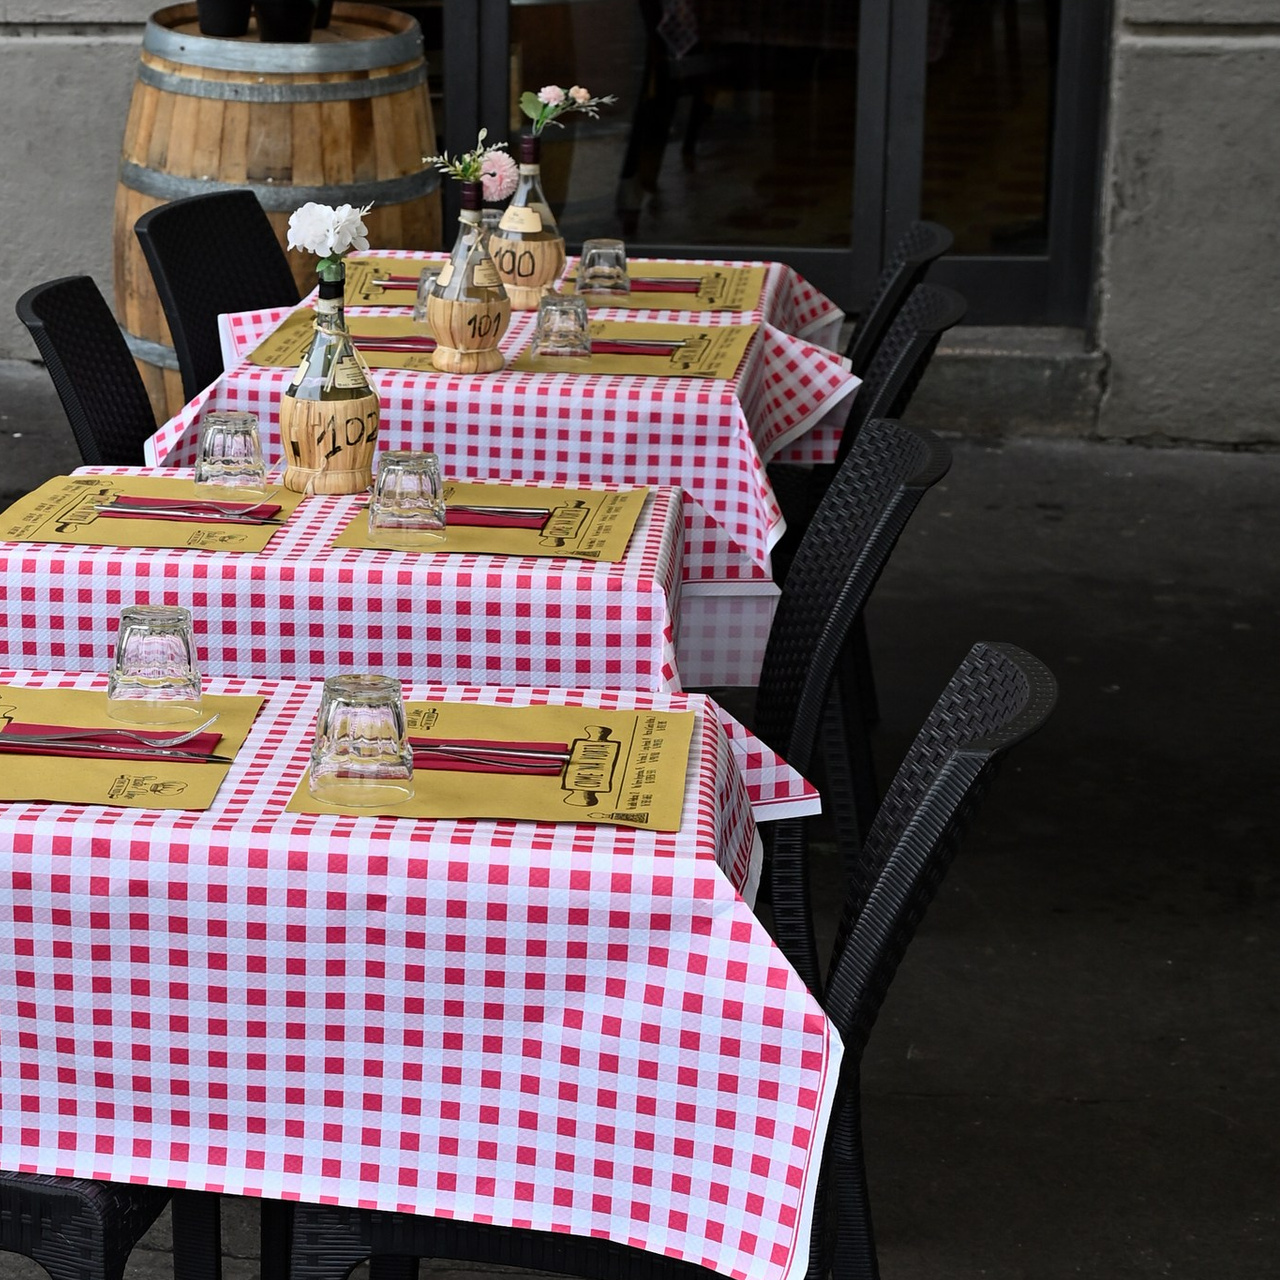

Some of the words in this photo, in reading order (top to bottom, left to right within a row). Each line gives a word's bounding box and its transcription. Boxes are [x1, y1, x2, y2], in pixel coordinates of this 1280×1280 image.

[493, 247, 536, 278] 100
[467, 311, 501, 339] 101
[316, 411, 379, 460] 102
